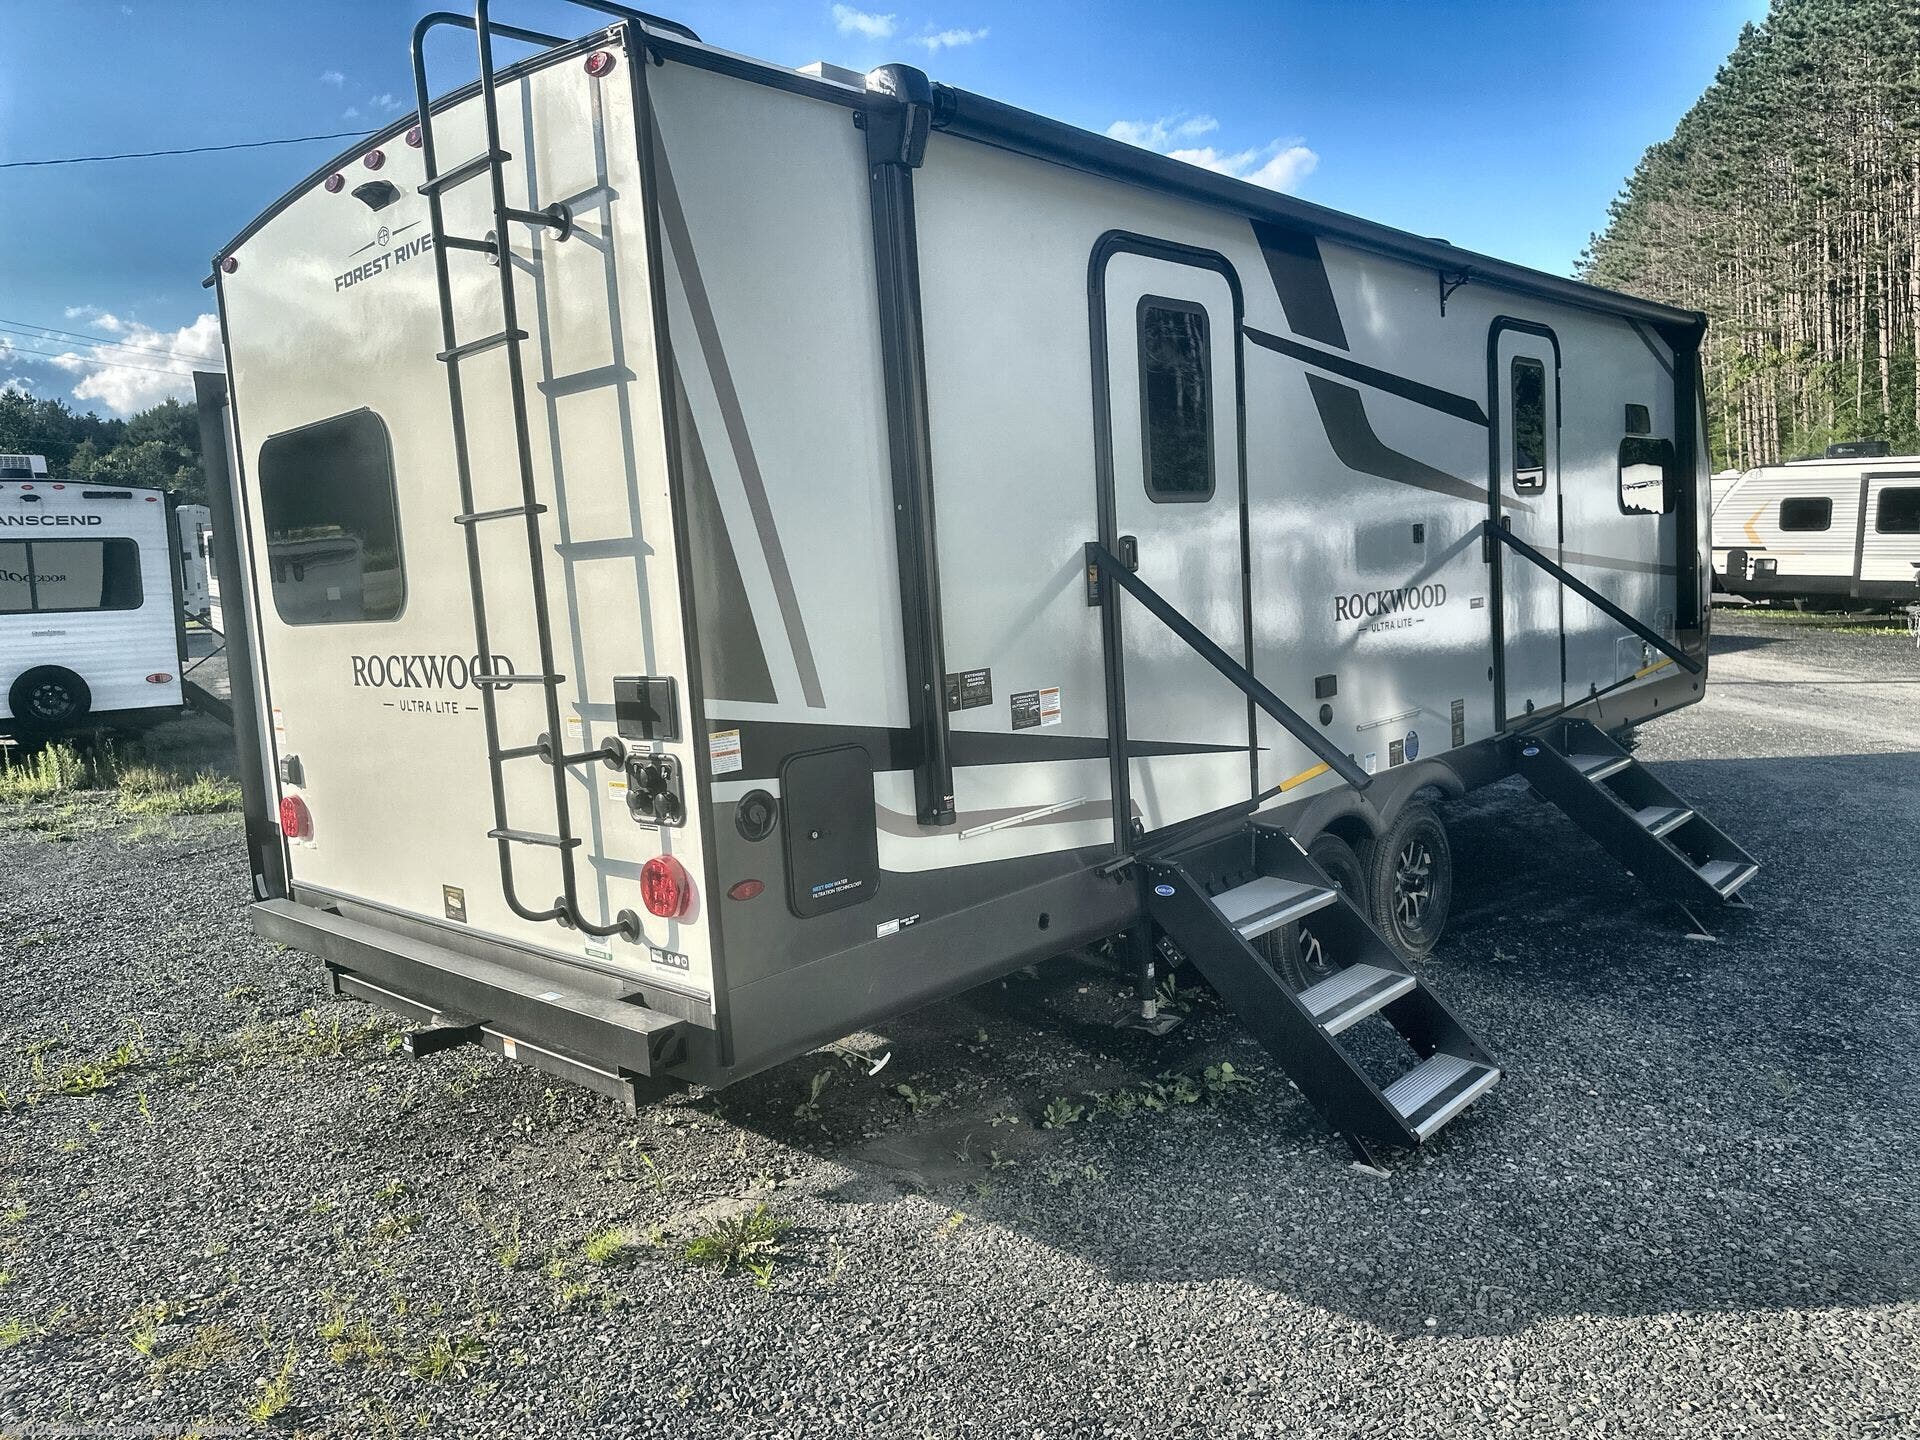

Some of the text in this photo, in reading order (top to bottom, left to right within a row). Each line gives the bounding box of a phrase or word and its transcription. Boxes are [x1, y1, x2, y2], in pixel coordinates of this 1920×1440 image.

[334, 232, 434, 293] FOREST RIVE
[1334, 583, 1447, 622] ROCKWOOD
[1371, 617, 1413, 633] ULTRA LITE
[400, 700, 459, 714] ULTRA LITE
